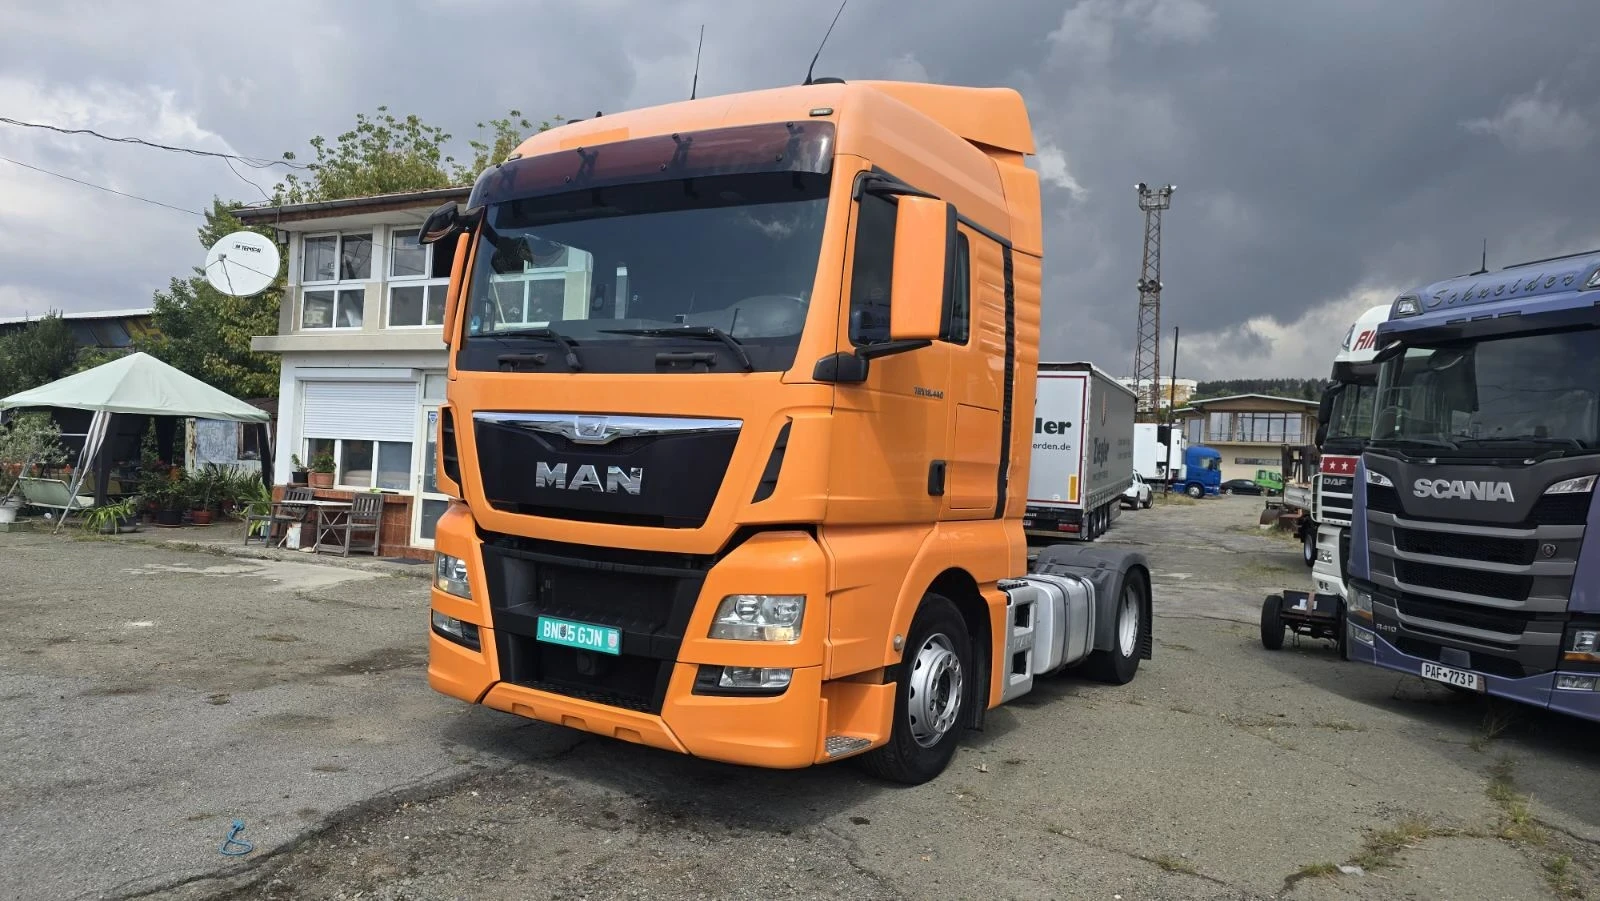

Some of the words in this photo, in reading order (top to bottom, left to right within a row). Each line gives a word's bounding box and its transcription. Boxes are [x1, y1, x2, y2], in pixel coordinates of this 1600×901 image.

[1427, 272, 1575, 309] Schneider
[535, 461, 643, 496] MAN
[1323, 477, 1347, 487] DAF
[1412, 478, 1515, 503] SCANIA
